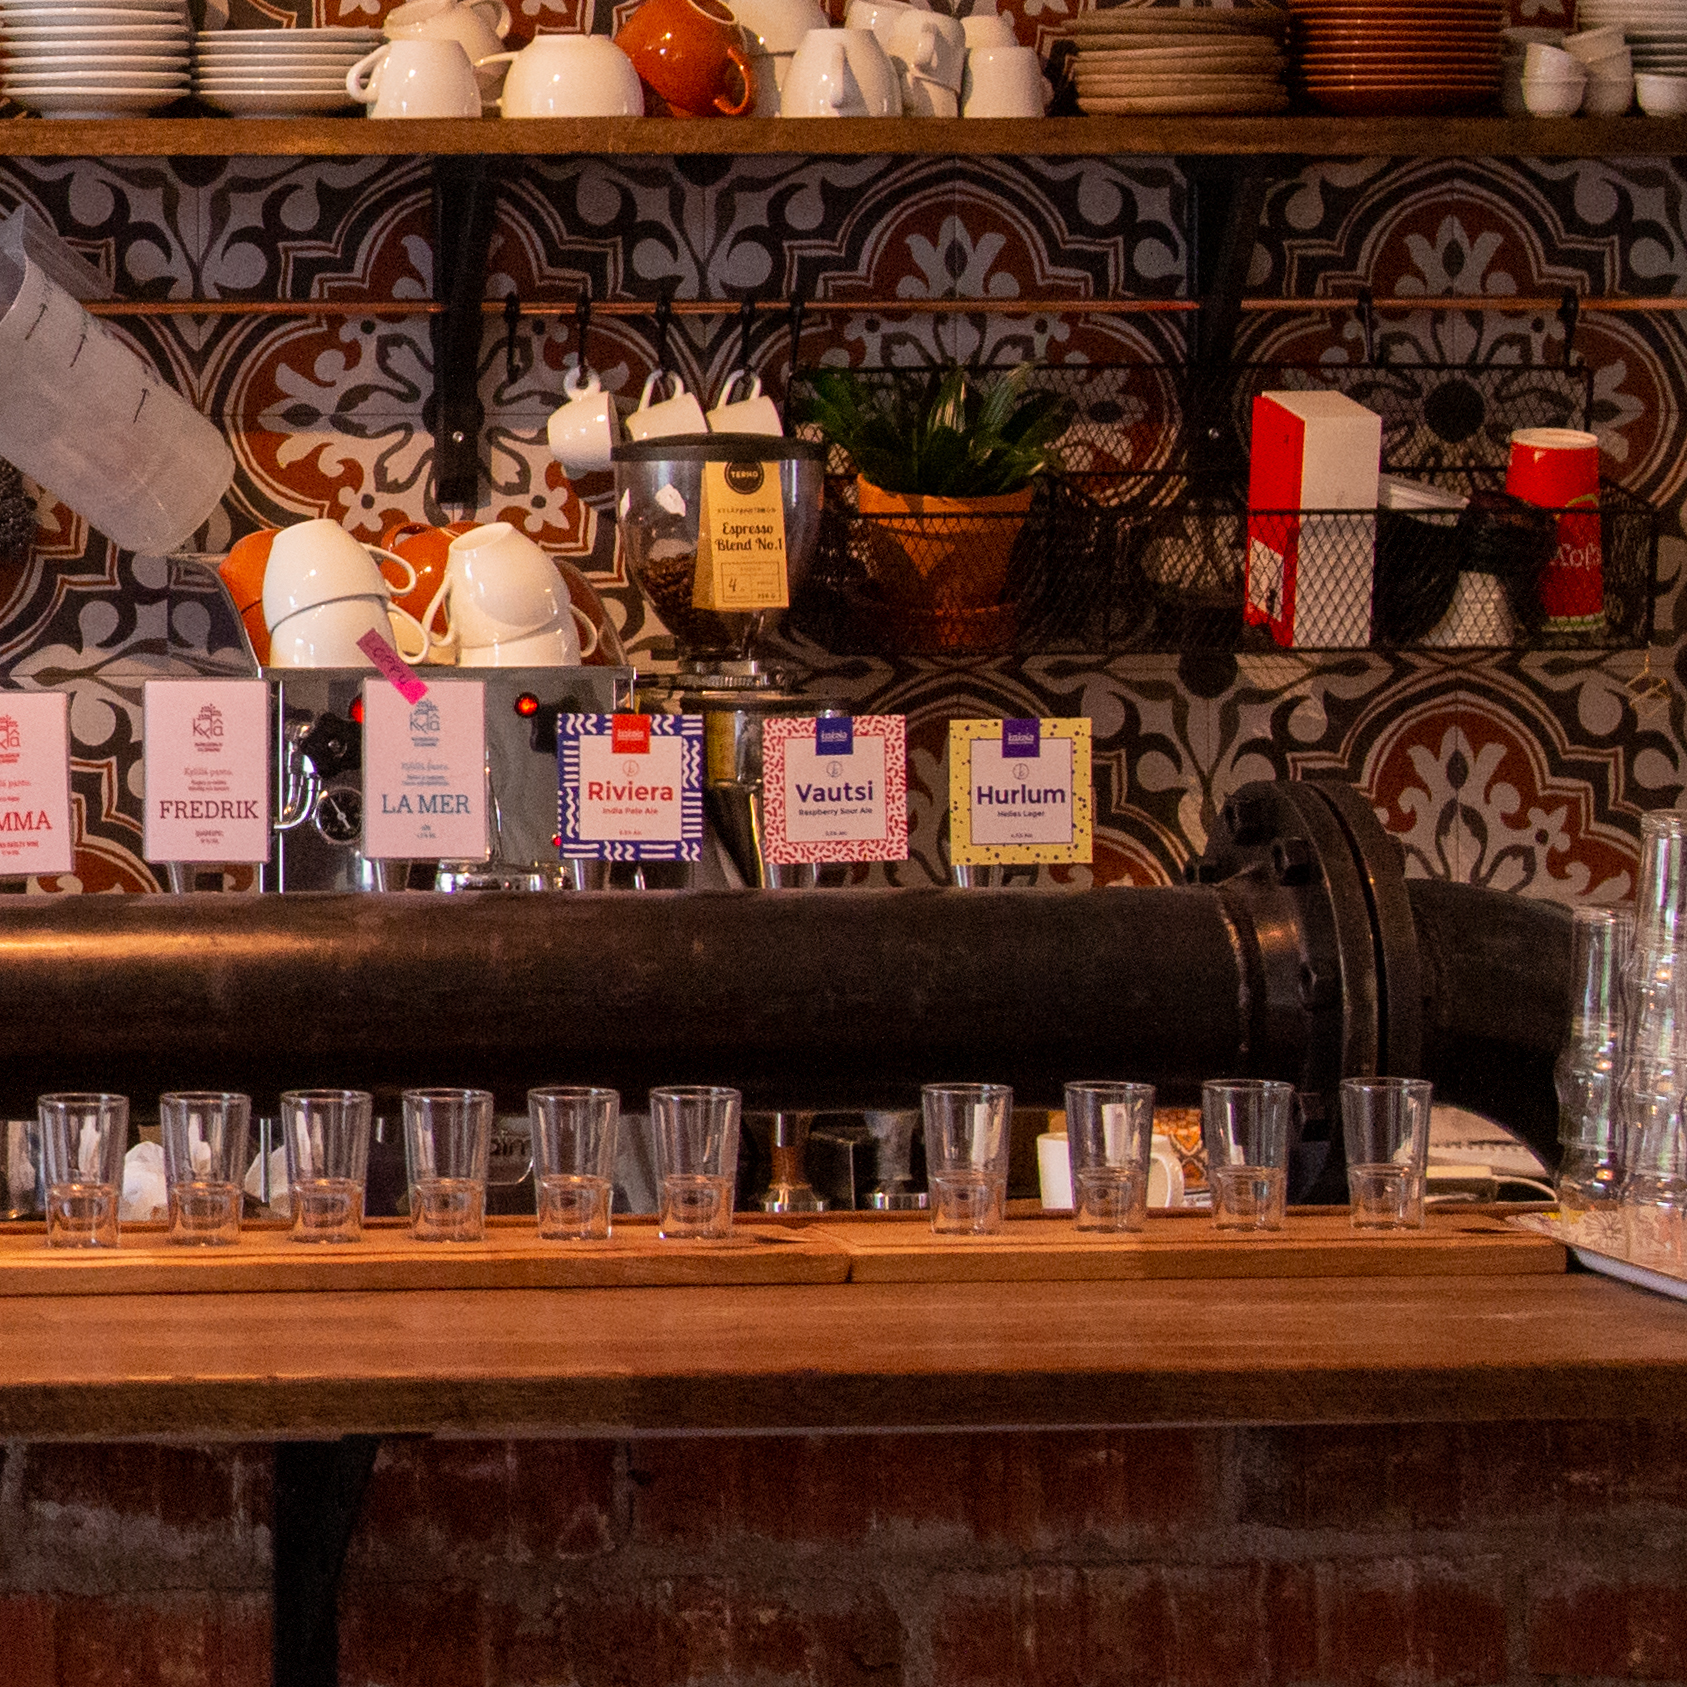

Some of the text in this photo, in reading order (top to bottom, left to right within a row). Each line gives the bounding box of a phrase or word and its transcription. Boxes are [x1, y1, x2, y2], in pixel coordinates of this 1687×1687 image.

[722, 522, 774, 538] Espresso
[714, 538, 752, 551] Blend
[587, 780, 674, 802] Riviera
[795, 780, 874, 803] Vautsi
[976, 783, 1066, 805] Hurlum
[159, 800, 260, 820] FREDRIK
[417, 793, 471, 814] MER
[798, 808, 838, 817] Raspberry
[840, 807, 858, 815] Sour
